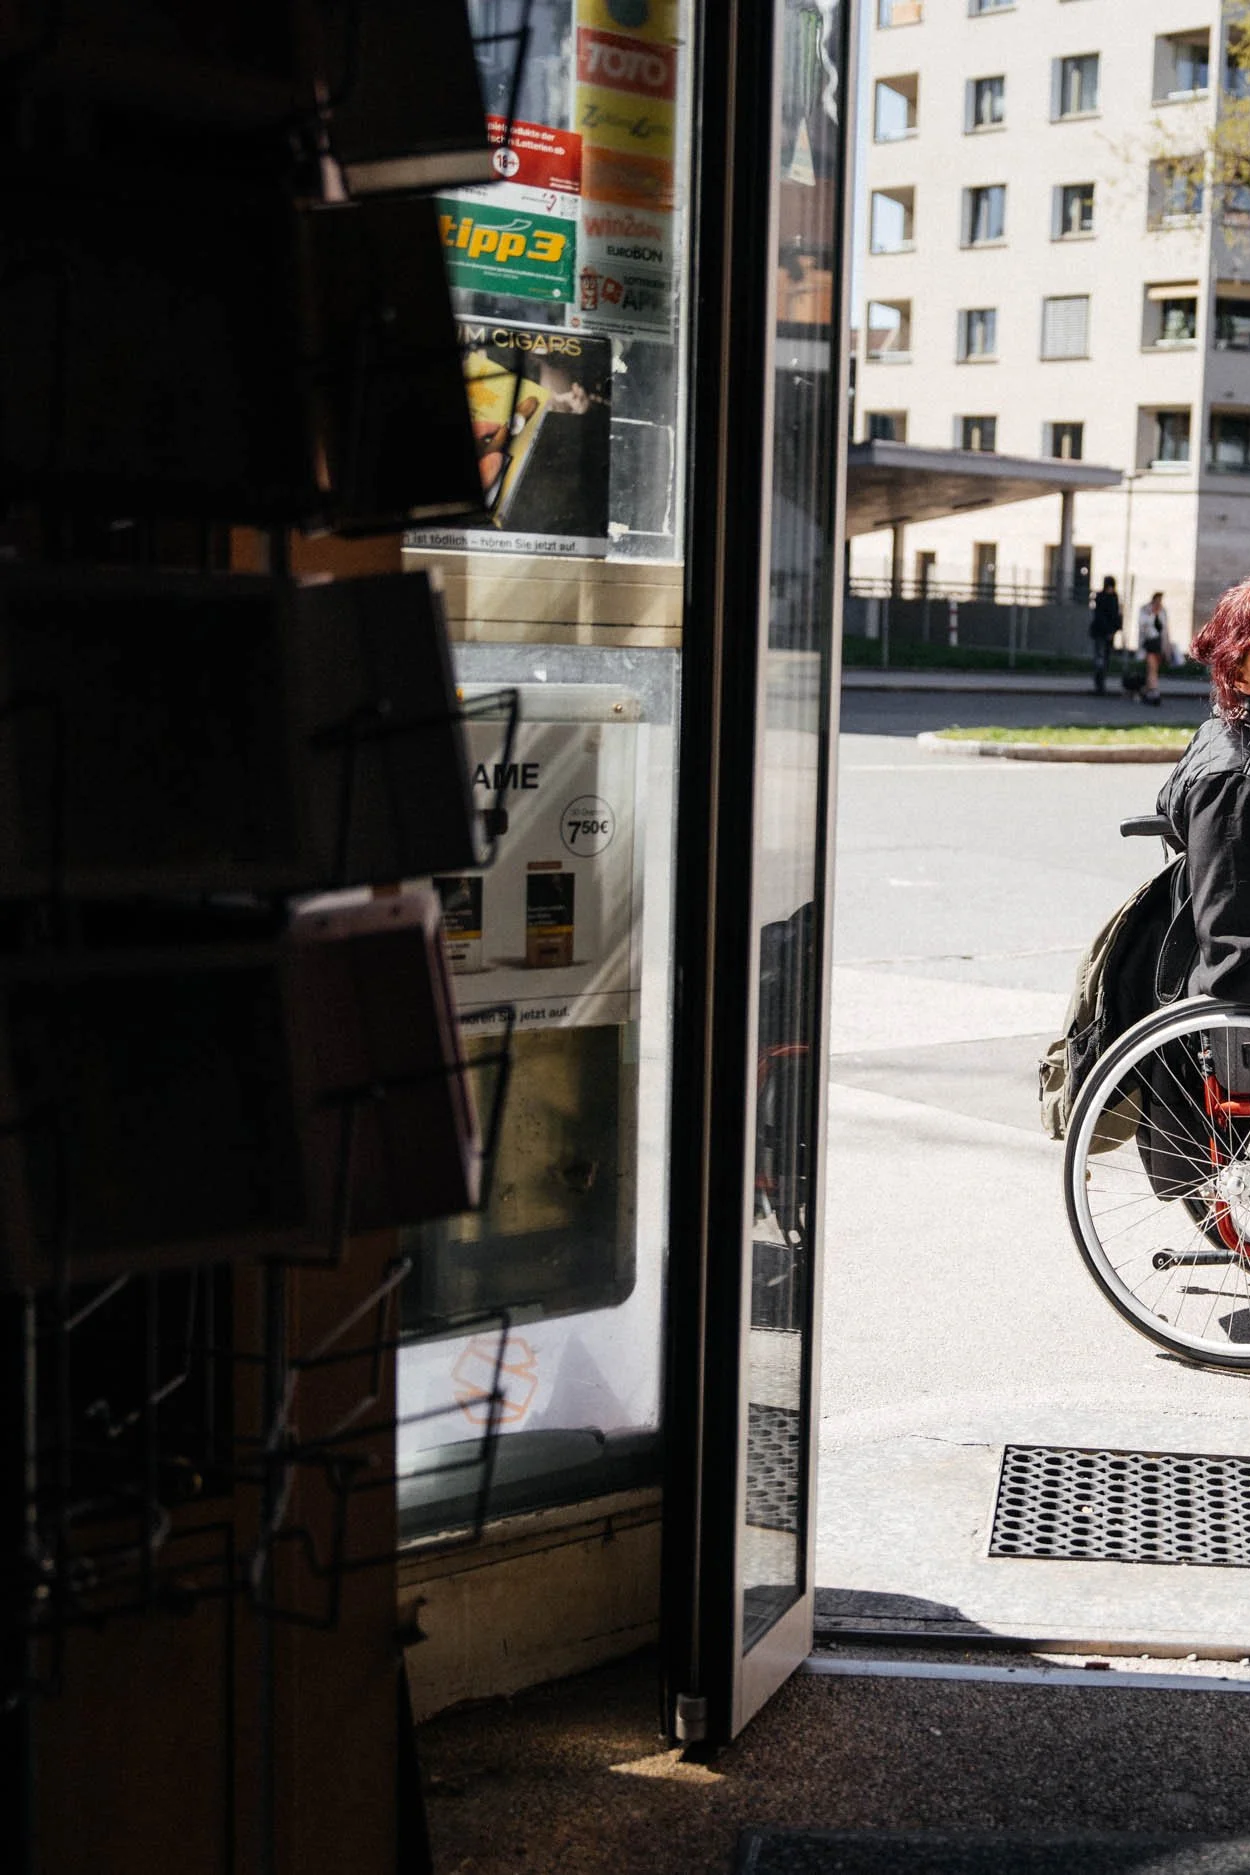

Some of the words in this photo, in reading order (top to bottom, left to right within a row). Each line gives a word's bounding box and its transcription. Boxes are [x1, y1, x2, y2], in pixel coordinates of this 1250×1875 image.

[584, 40, 668, 86] TOTO
[438, 214, 567, 263] tipp3
[492, 328, 582, 356] CIGARS
[413, 533, 428, 544] ist
[430, 533, 468, 546] tödlich
[480, 536, 512, 548] hören
[515, 538, 531, 549] Sie
[534, 539, 557, 551] jetzt
[473, 763, 540, 790] AME
[520, 1008, 546, 1022] jetzt
[549, 1006, 570, 1018] auf.
